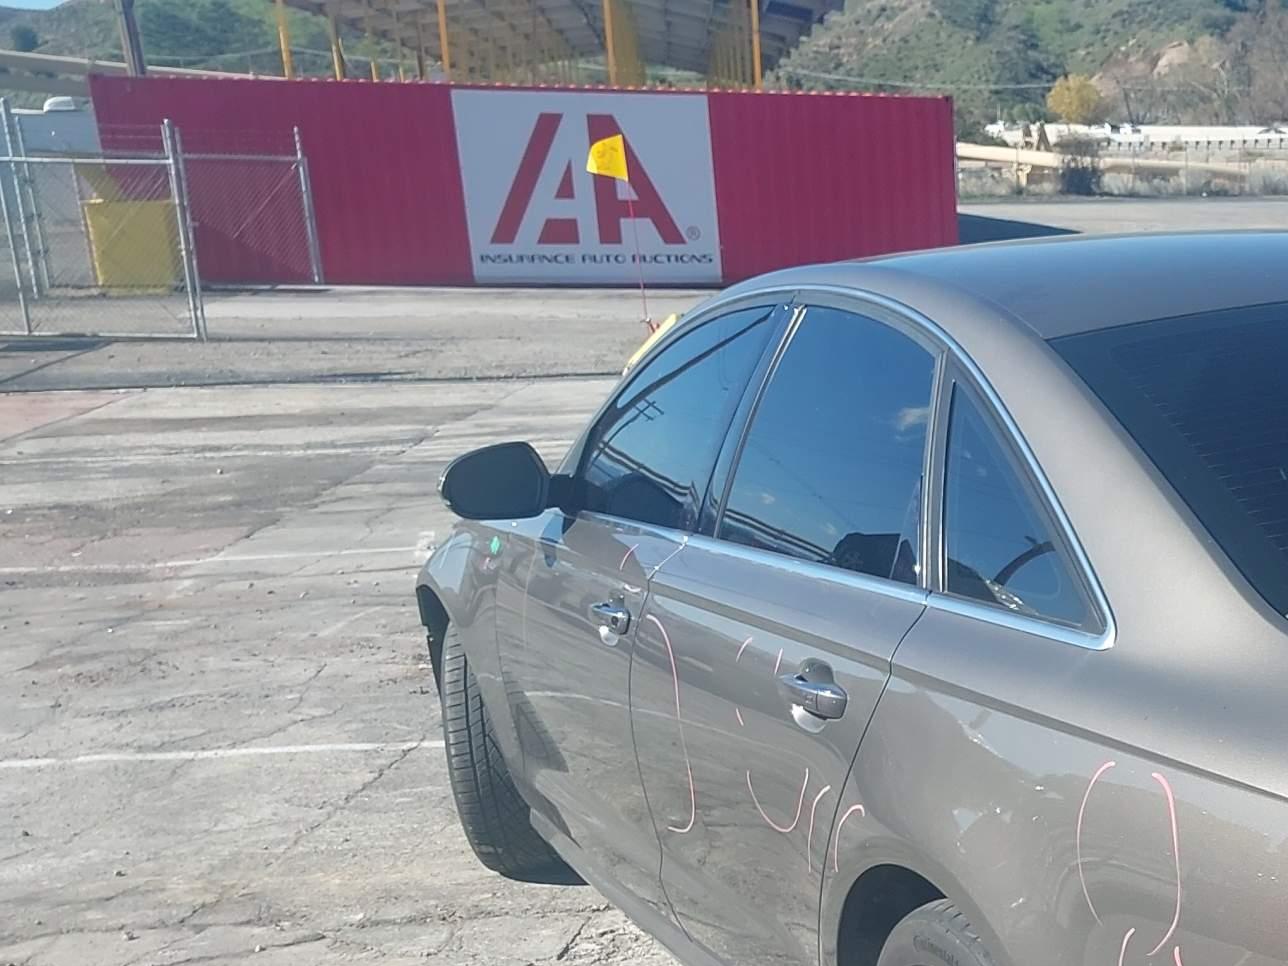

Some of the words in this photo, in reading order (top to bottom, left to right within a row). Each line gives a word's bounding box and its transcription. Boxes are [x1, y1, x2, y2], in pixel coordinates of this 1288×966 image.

[480, 253, 576, 265] INSURANCE
[581, 253, 627, 265] AUTO
[632, 253, 713, 265] AUCTIONS
